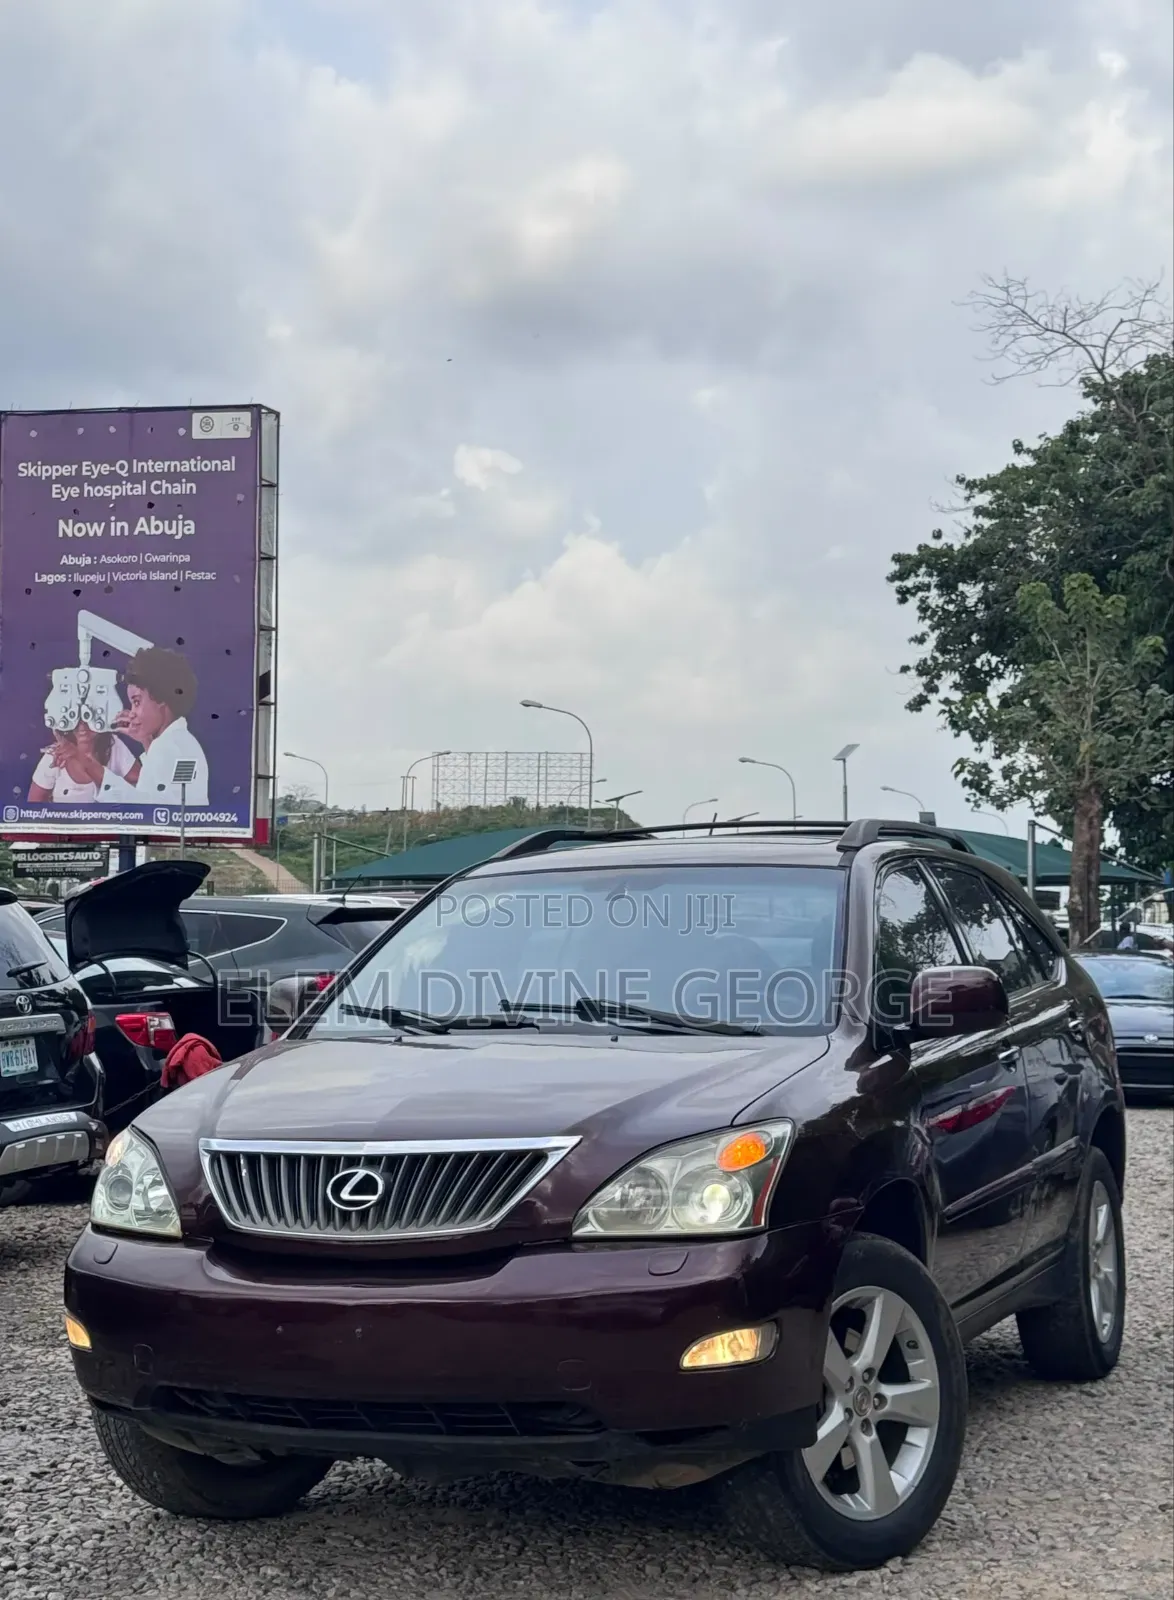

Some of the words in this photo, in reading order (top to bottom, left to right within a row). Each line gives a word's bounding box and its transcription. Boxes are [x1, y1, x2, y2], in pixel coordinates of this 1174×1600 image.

[17, 461, 78, 480] Skipper
[82, 460, 129, 478] Eye-Q
[132, 456, 236, 473] International
[51, 484, 80, 501] Eye
[83, 480, 147, 500] hospital
[150, 478, 197, 495] Chain
[58, 519, 106, 538] Now
[110, 516, 129, 537] in
[133, 514, 196, 540] Abuja
[60, 554, 92, 567] Abuja
[99, 554, 138, 564] Asokoro
[144, 552, 191, 564] Gwarinpa
[34, 572, 67, 584] Lagos
[73, 572, 106, 584] Ilupeju
[112, 571, 148, 581] Victoria
[149, 571, 178, 581] Island
[185, 570, 217, 580] Festac
[12, 853, 26, 861] MR
[27, 852, 74, 861] LOGISTICS
[74, 851, 100, 860] AUTO
